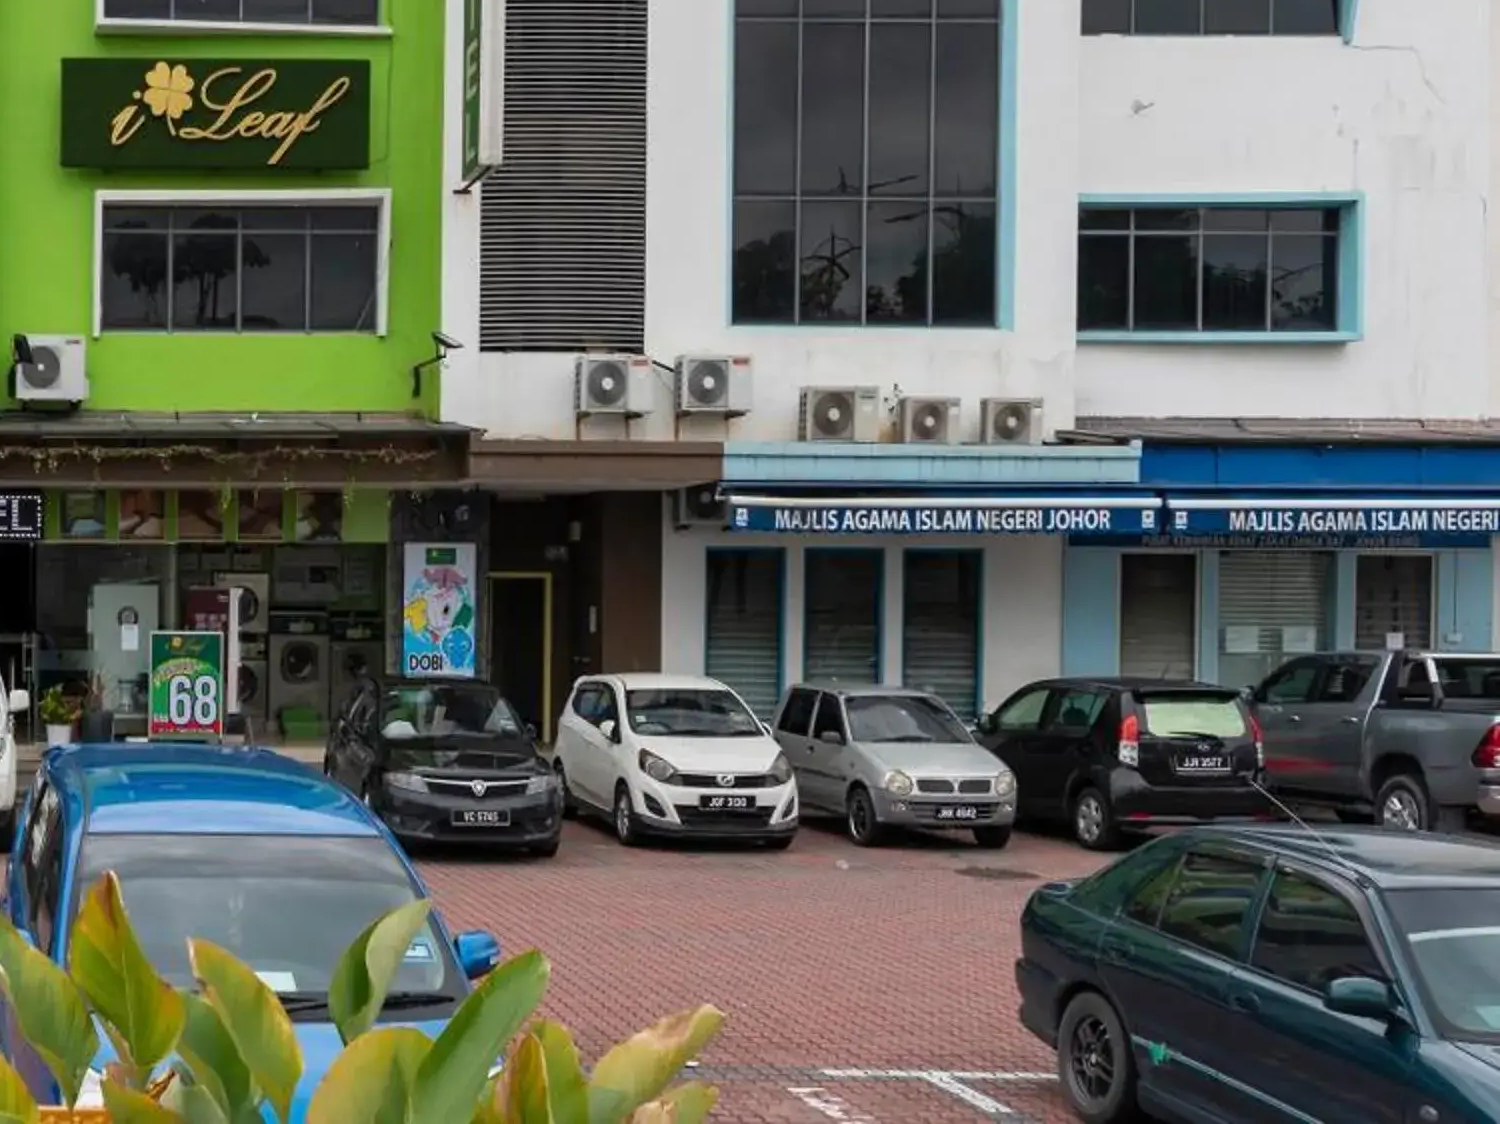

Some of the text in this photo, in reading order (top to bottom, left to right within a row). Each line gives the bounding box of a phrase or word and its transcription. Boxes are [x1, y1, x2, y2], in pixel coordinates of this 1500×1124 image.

[179, 67, 350, 165] Leaf
[775, 509, 1111, 531] MAJLIS AGAMA ISLAM NEGERI JOHOR
[1229, 511, 1499, 532] MAJLIS AGAMA ISLAM NEGERI
[409, 654, 443, 672] DOBI
[170, 675, 217, 725] 68
